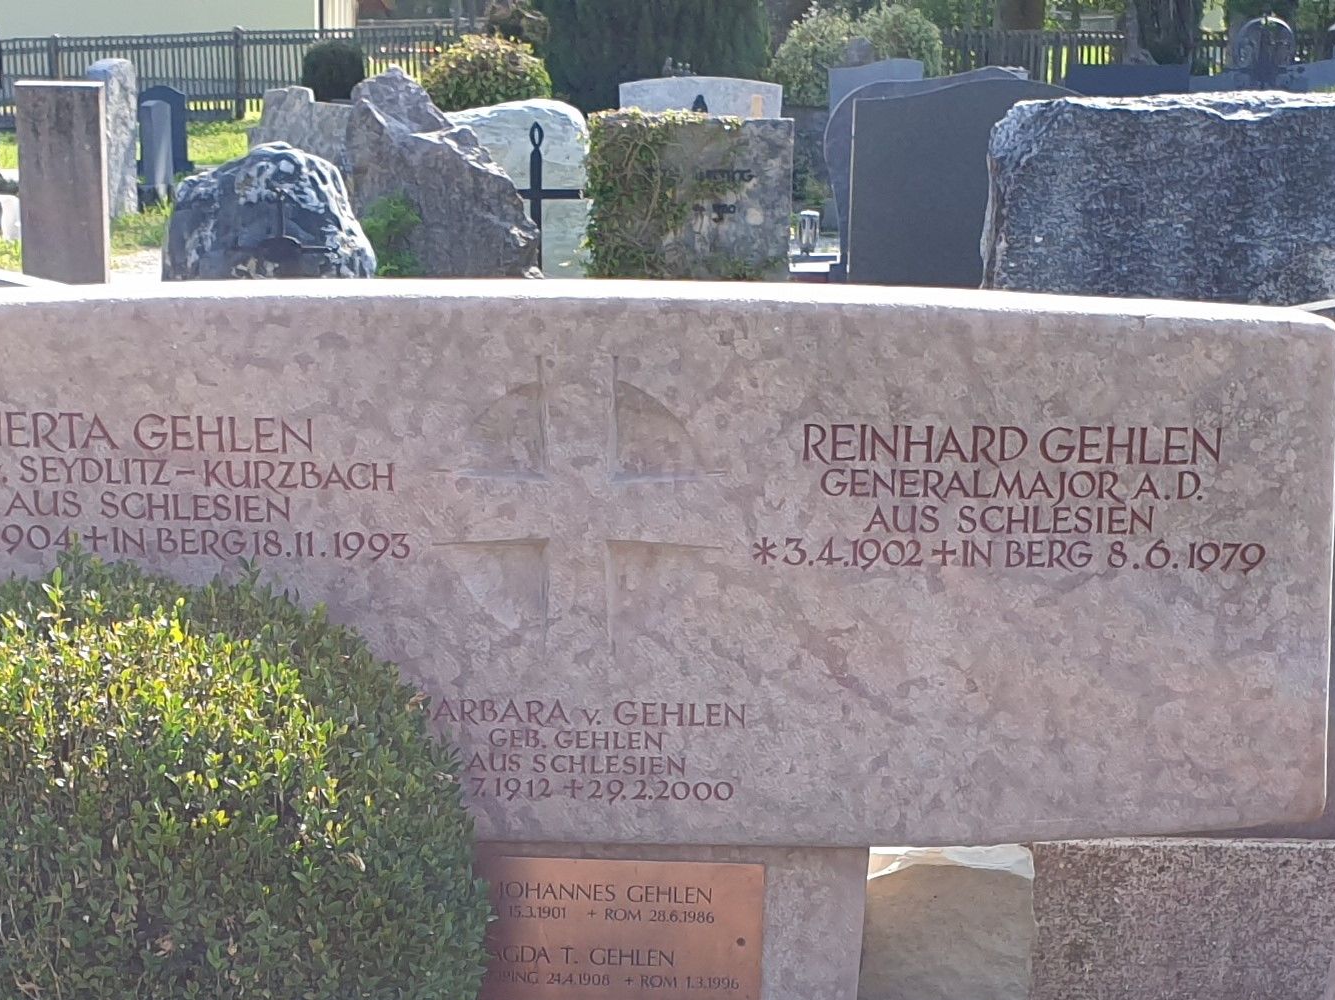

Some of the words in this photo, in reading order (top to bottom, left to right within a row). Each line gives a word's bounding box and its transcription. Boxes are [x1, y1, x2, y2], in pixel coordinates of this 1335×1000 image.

[133, 415, 314, 454] GEHLEN
[802, 423, 1028, 468] REINHARD
[1039, 425, 1222, 467] GEHLEN
[819, 468, 1122, 507] GENERALMAJOR
[4, 490, 82, 518] AUS
[100, 492, 291, 523] SCHLESIEN
[862, 504, 940, 535] AUS
[957, 505, 1154, 536] SCHLESIEN
[156, 527, 248, 561] BERG
[1005, 540, 1092, 572] BERG
[426, 698, 570, 728] ARBARA
[615, 701, 747, 729] GEHLEN
[488, 728, 547, 749] GEB.
[554, 729, 664, 751] GEHLEN
[467, 752, 522, 773] AUS
[533, 754, 687, 777] SCHLESIEN
[499, 881, 616, 902] JOHANNES
[627, 885, 712, 904] GEHLEN
[605, 908, 642, 922] ROM
[561, 946, 579, 965] T.
[589, 949, 675, 968] GEHLEN
[640, 975, 677, 989] ROM
